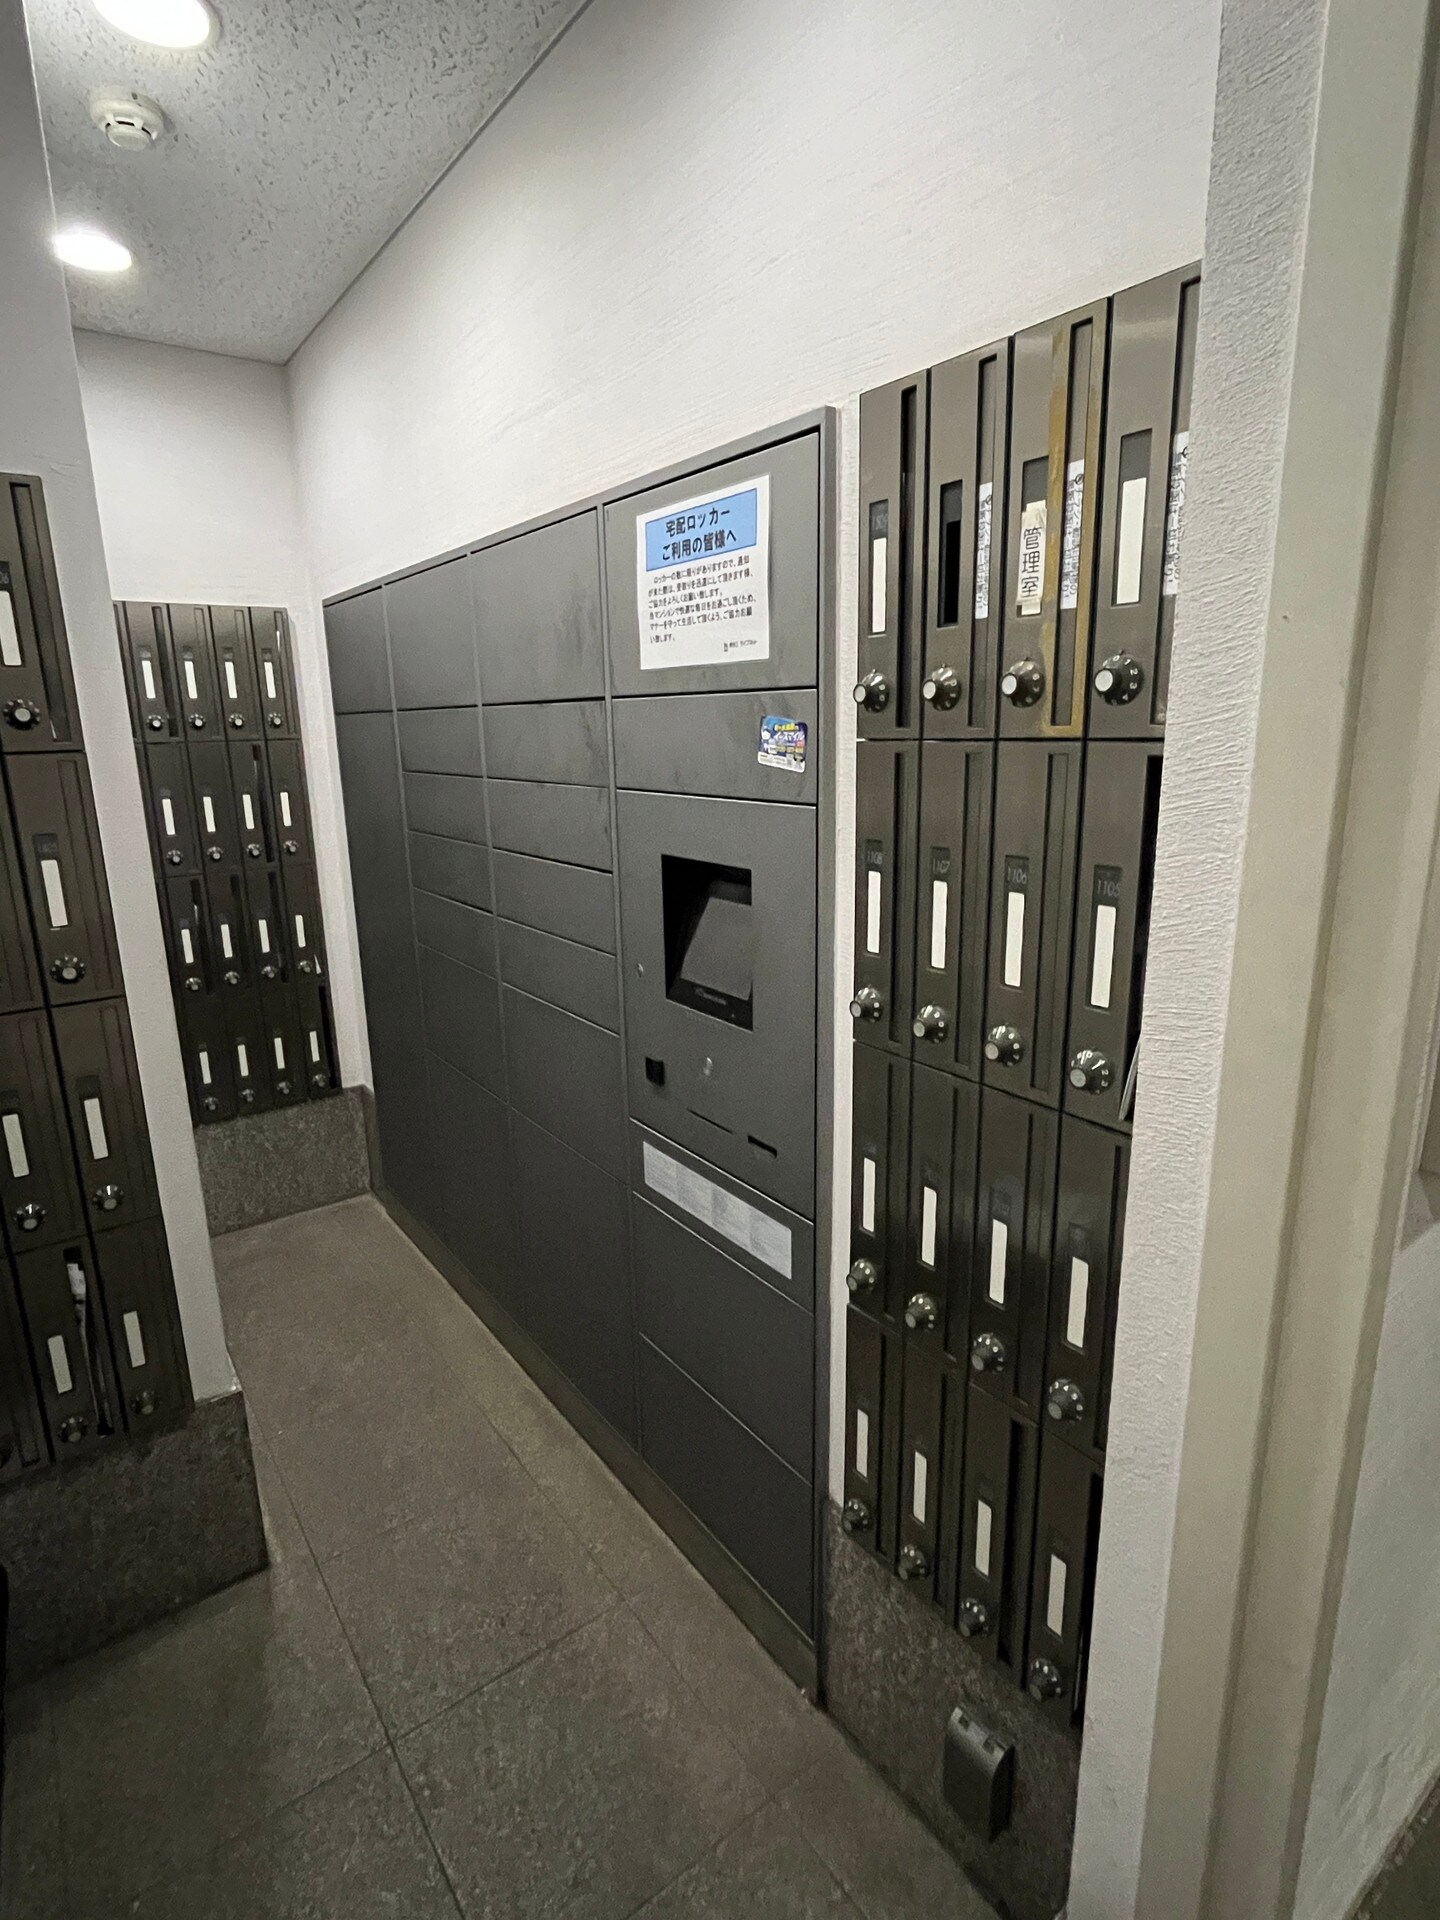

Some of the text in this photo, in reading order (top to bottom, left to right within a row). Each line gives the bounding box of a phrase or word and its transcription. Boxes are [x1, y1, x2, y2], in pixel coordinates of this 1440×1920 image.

[666, 507, 730, 537] 宅配ロッカー
[662, 529, 737, 560] ご利用の皆様へ
[1021, 527, 1041, 598] 管理室
[1007, 866, 1028, 885] 1106
[1097, 879, 1121, 898] 1105
